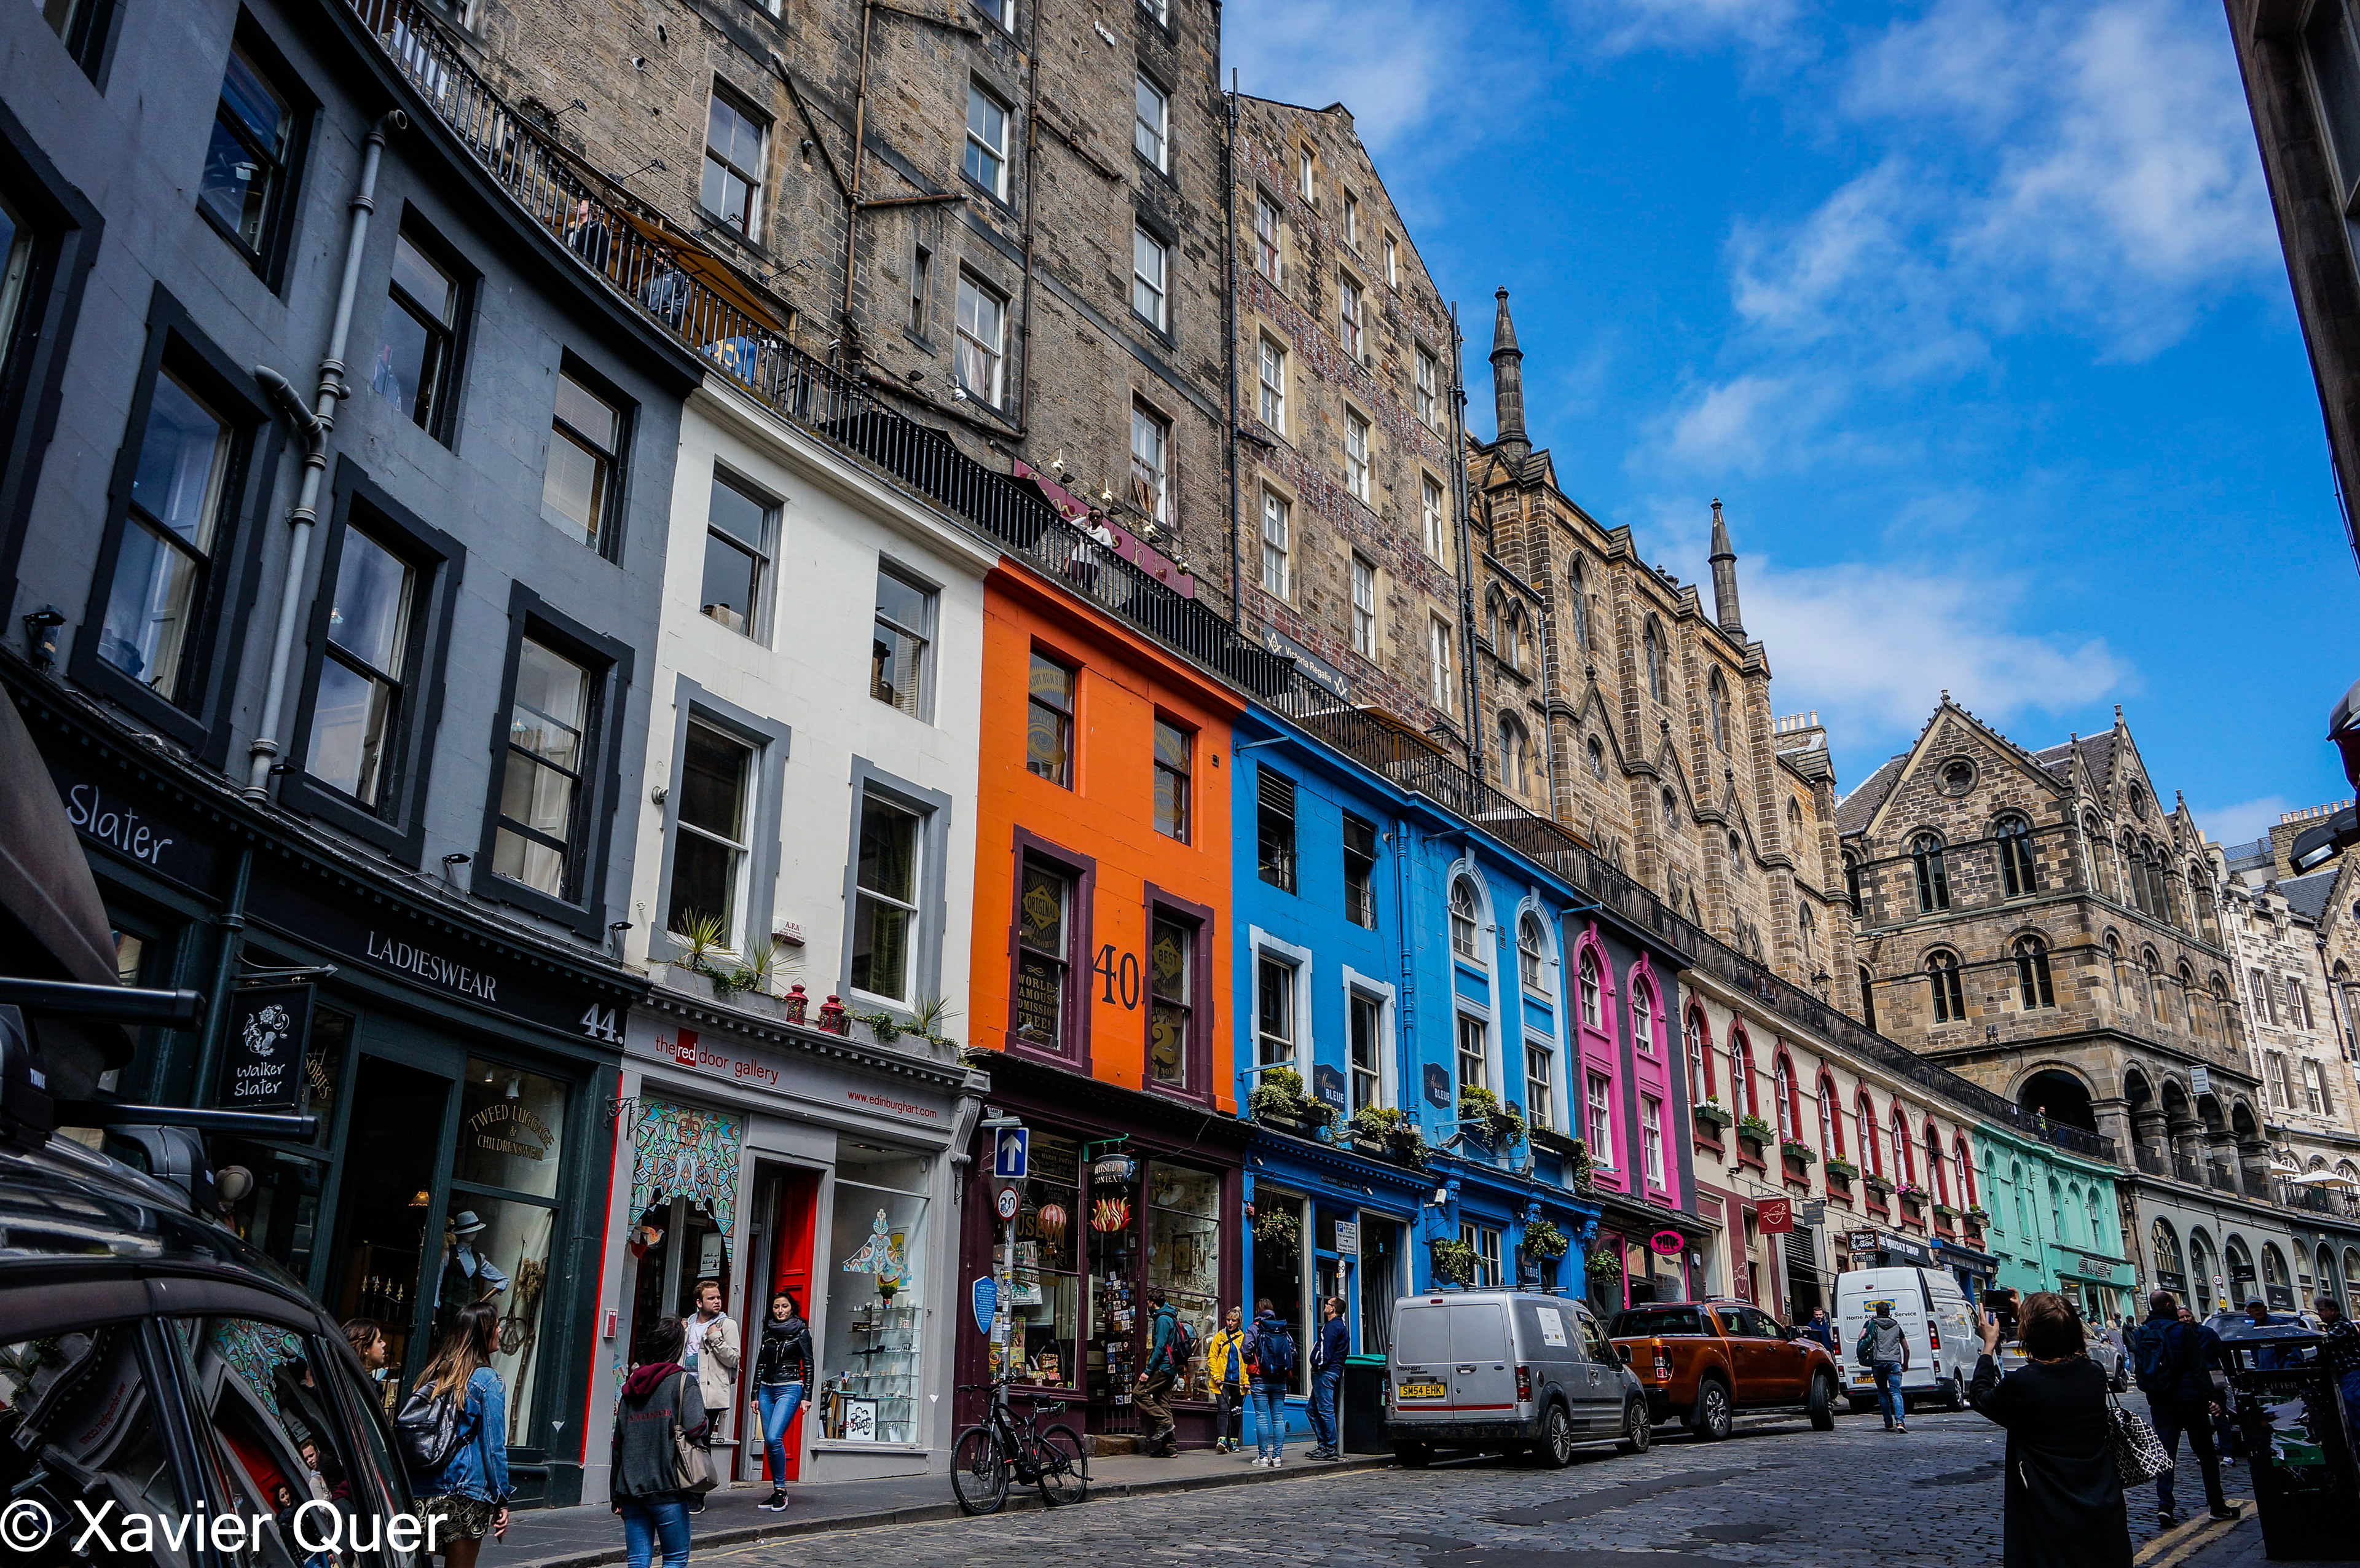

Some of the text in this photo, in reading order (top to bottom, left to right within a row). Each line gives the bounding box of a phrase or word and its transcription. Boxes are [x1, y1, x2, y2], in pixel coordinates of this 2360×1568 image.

[1285, 645, 1332, 683] Victoria Regalia
[65, 783, 173, 864] Slater
[1027, 896, 1056, 919] ORIGINAL
[368, 930, 497, 1002] LADIESWEAR
[1158, 949, 1178, 966] BEST
[1093, 944, 1139, 1011] 40
[1018, 986, 1053, 1005] AMOUS
[1018, 998, 1057, 1018] DMISSION
[1018, 1011, 1051, 1030] FREE!
[655, 1034, 779, 1085] the red door gallery
[1326, 1088, 1345, 1104] BLEUE
[1434, 1088, 1451, 1102] BLEUE
[468, 1104, 555, 1151] TWEED LUGGAGE
[509, 1125, 517, 1137] &
[477, 1134, 543, 1161] CHILDRENSWEAR
[1094, 1162, 1123, 1175] MUSEUM
[1906, 1244, 1919, 1256] SHOP
[1402, 1386, 1441, 1395] SM54 EHK
